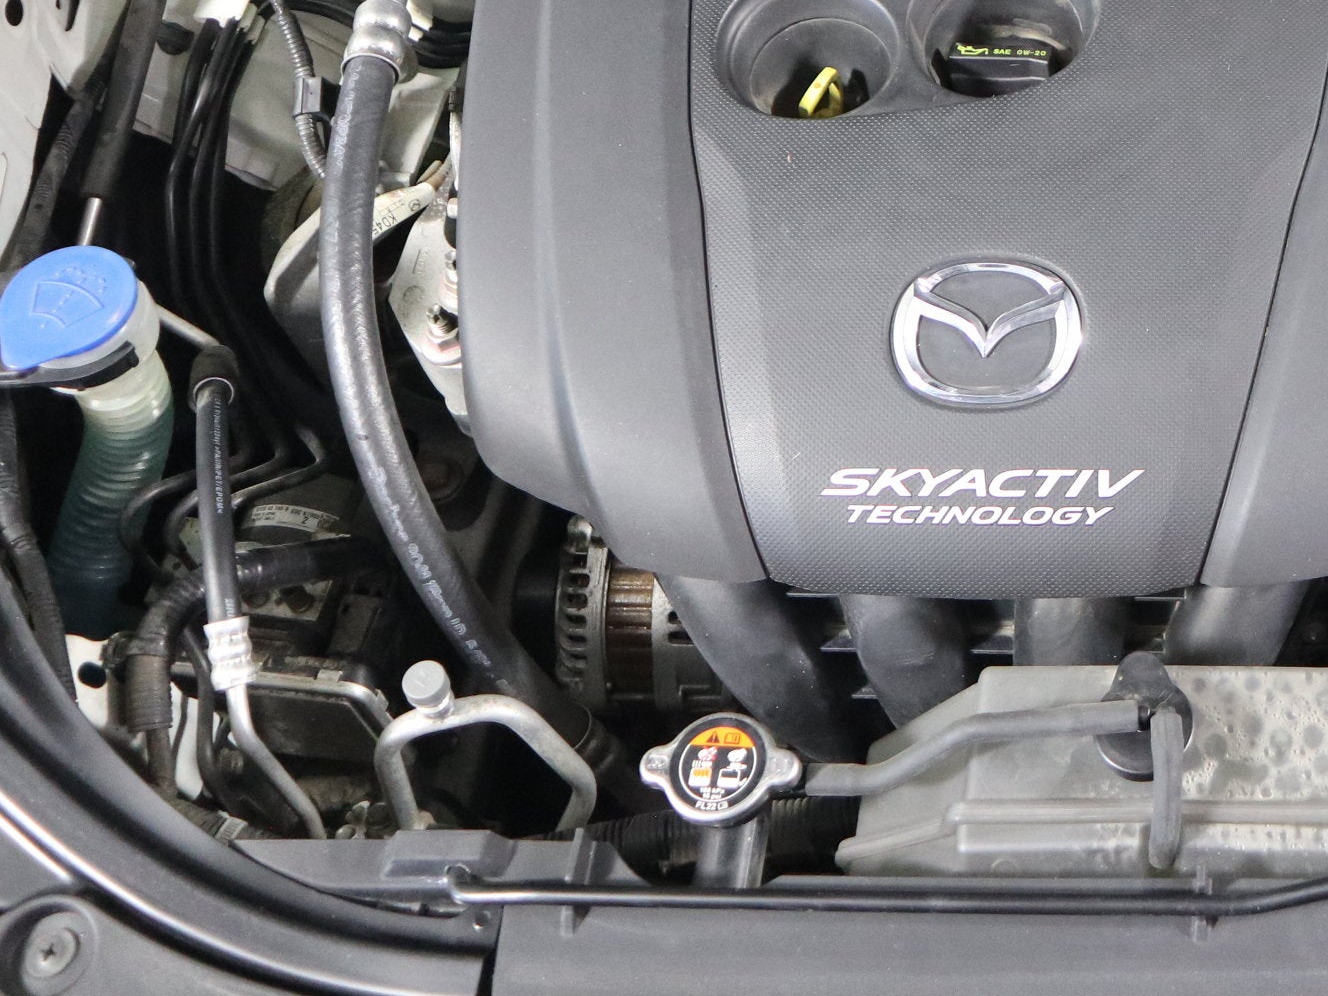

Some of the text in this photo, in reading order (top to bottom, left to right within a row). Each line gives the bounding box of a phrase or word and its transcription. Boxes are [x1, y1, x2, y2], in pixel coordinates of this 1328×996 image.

[820, 467, 1146, 499] SKYACTIV
[847, 504, 1115, 526] TECHNOLOGY
[695, 800, 717, 811] FL22
